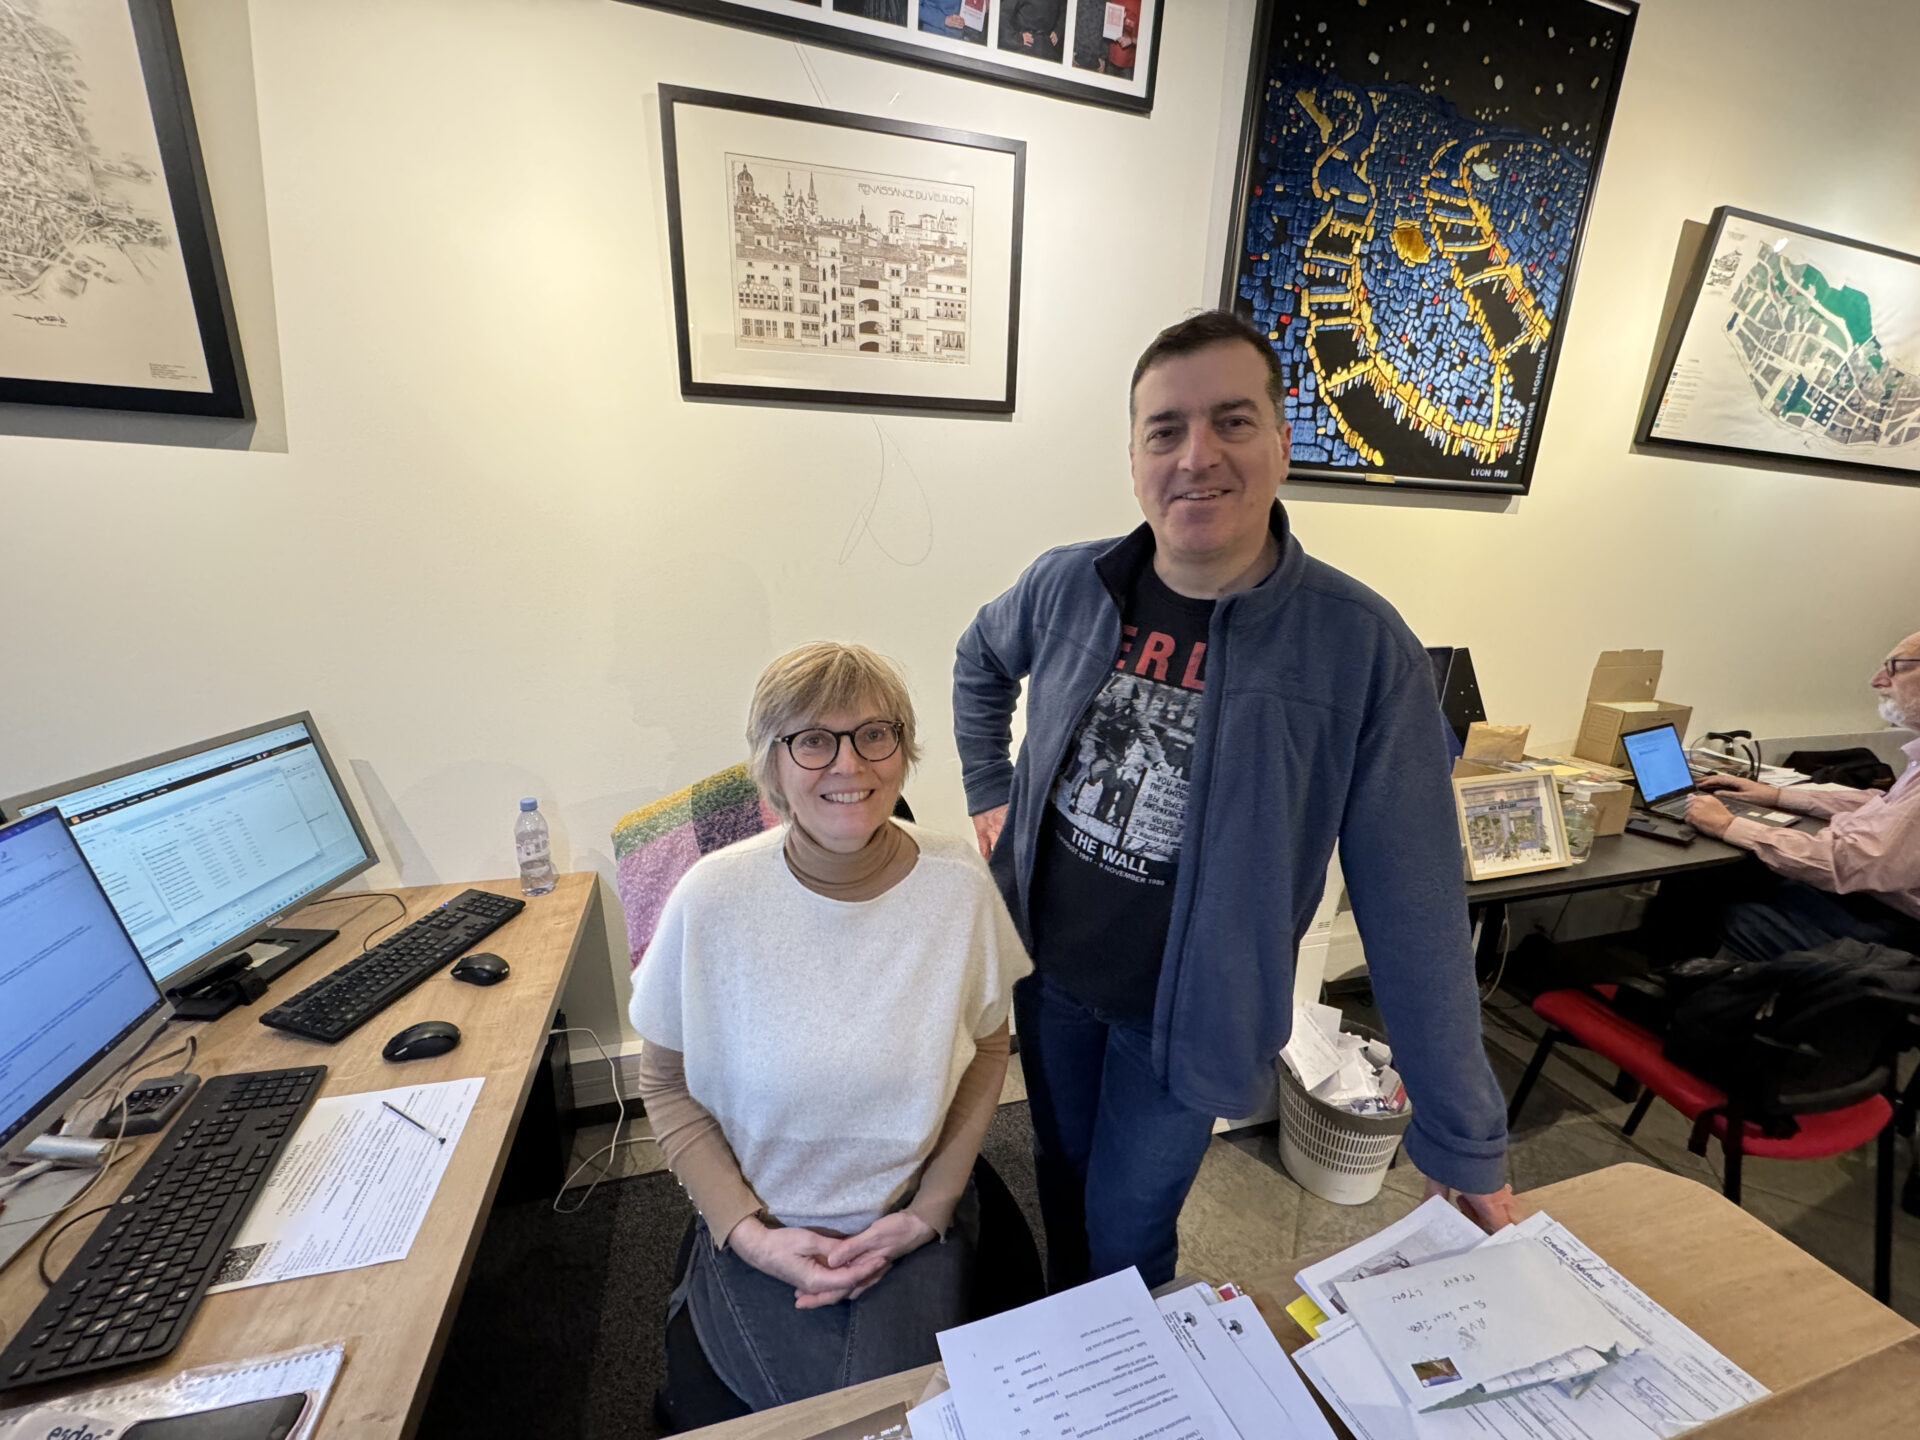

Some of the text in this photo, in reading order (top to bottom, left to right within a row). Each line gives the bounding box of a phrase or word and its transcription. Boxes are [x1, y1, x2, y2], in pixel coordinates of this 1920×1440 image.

[858, 183, 914, 199] RENAISSANCE
[1516, 346, 1548, 465] PATRIMOINE MONDIAL
[1471, 468, 1491, 477] LYON
[1157, 776, 1172, 787] YOU
[1071, 827, 1099, 855] THE
[1102, 844, 1149, 876] WALL
[1104, 864, 1147, 884] NOVEMBER
[1542, 1234, 1605, 1291] Crédit Mutuel
[1390, 1287, 1423, 1303] LYON
